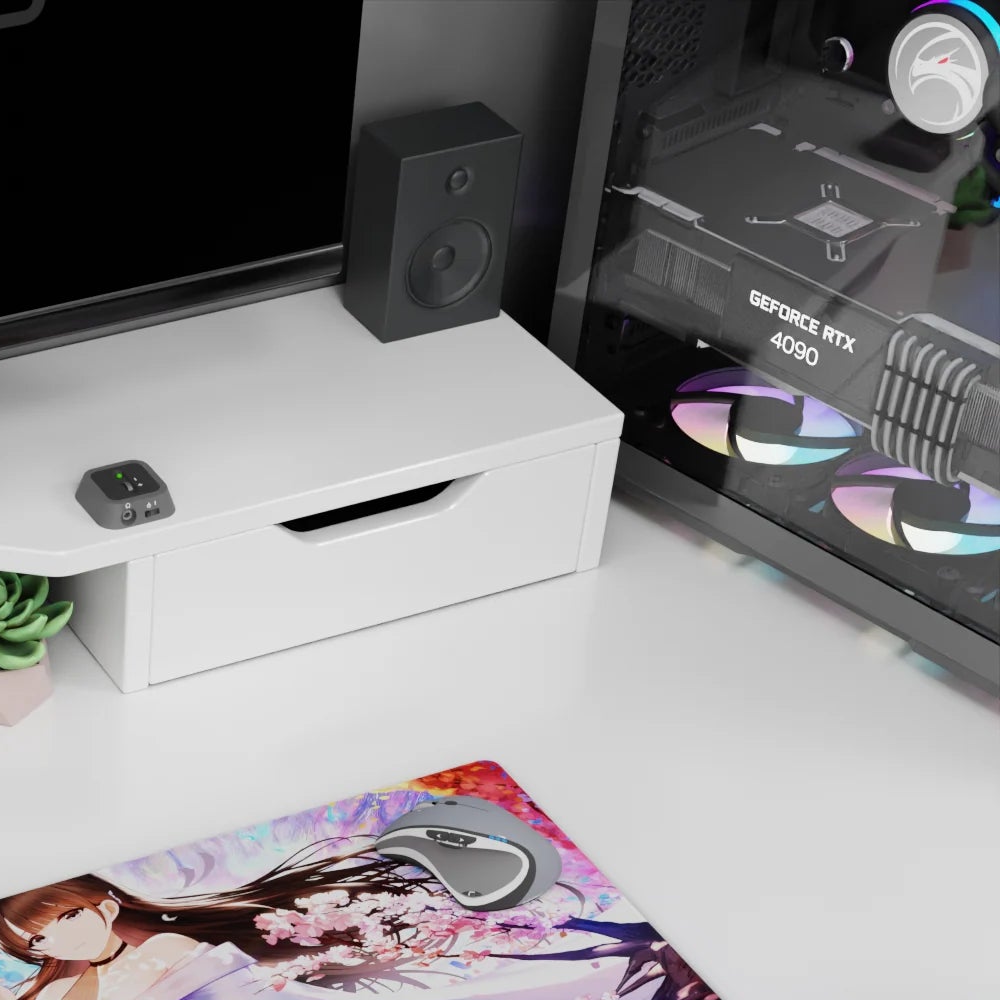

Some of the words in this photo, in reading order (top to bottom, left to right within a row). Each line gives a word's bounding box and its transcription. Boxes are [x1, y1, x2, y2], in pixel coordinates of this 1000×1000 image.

[749, 289, 820, 336] GEFORCE
[822, 324, 856, 354] RTX
[770, 331, 819, 367] 4090
